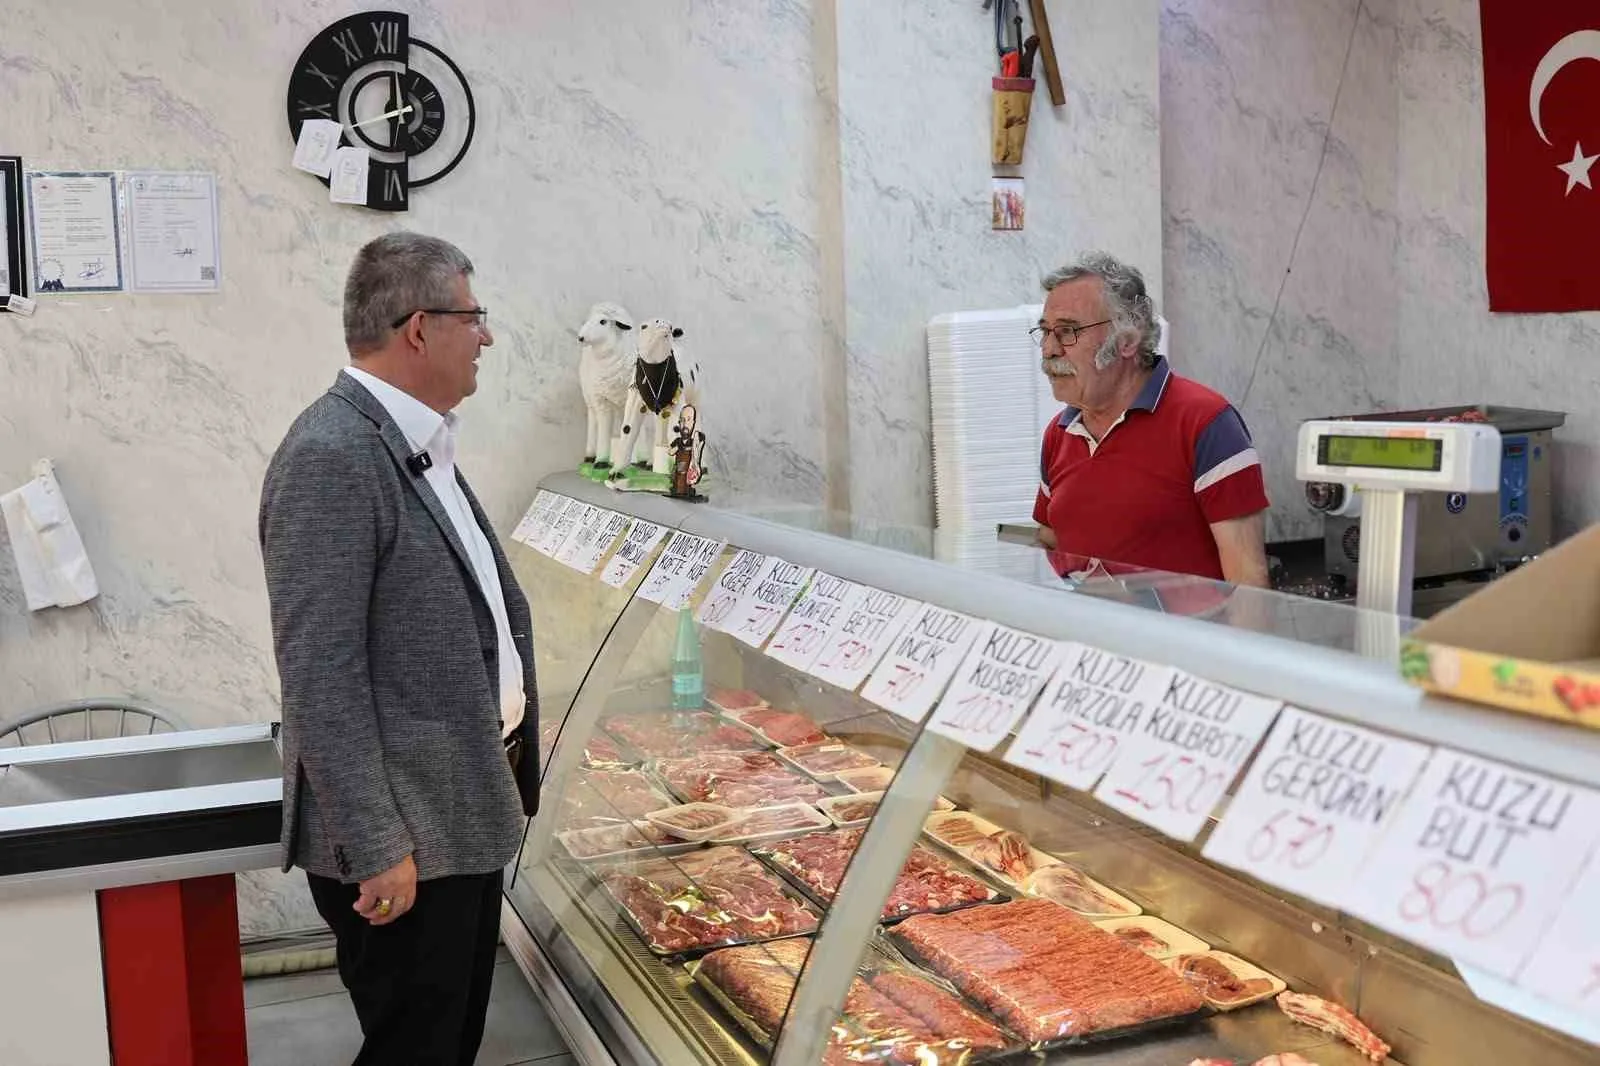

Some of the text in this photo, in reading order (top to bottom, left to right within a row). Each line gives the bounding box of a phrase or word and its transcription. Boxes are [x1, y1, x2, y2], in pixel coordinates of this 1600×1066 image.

[332, 28, 363, 67] XI
[371, 22, 399, 55] XII
[767, 561, 807, 586] KUZU
[813, 574, 852, 602] KUZU
[862, 590, 906, 619] KUZU
[914, 609, 970, 644] KUZU
[982, 627, 1053, 671] KUZU
[1072, 649, 1145, 694] KUZU
[1162, 672, 1243, 724] KUZU
[1285, 718, 1385, 775] KUZU
[1114, 751, 1226, 815] 1500
[1260, 754, 1399, 824] GERDAN
[1438, 759, 1575, 832] KUZU
[1245, 807, 1336, 871] 670
[1418, 804, 1531, 869] BUT
[1398, 858, 1526, 941] 800
